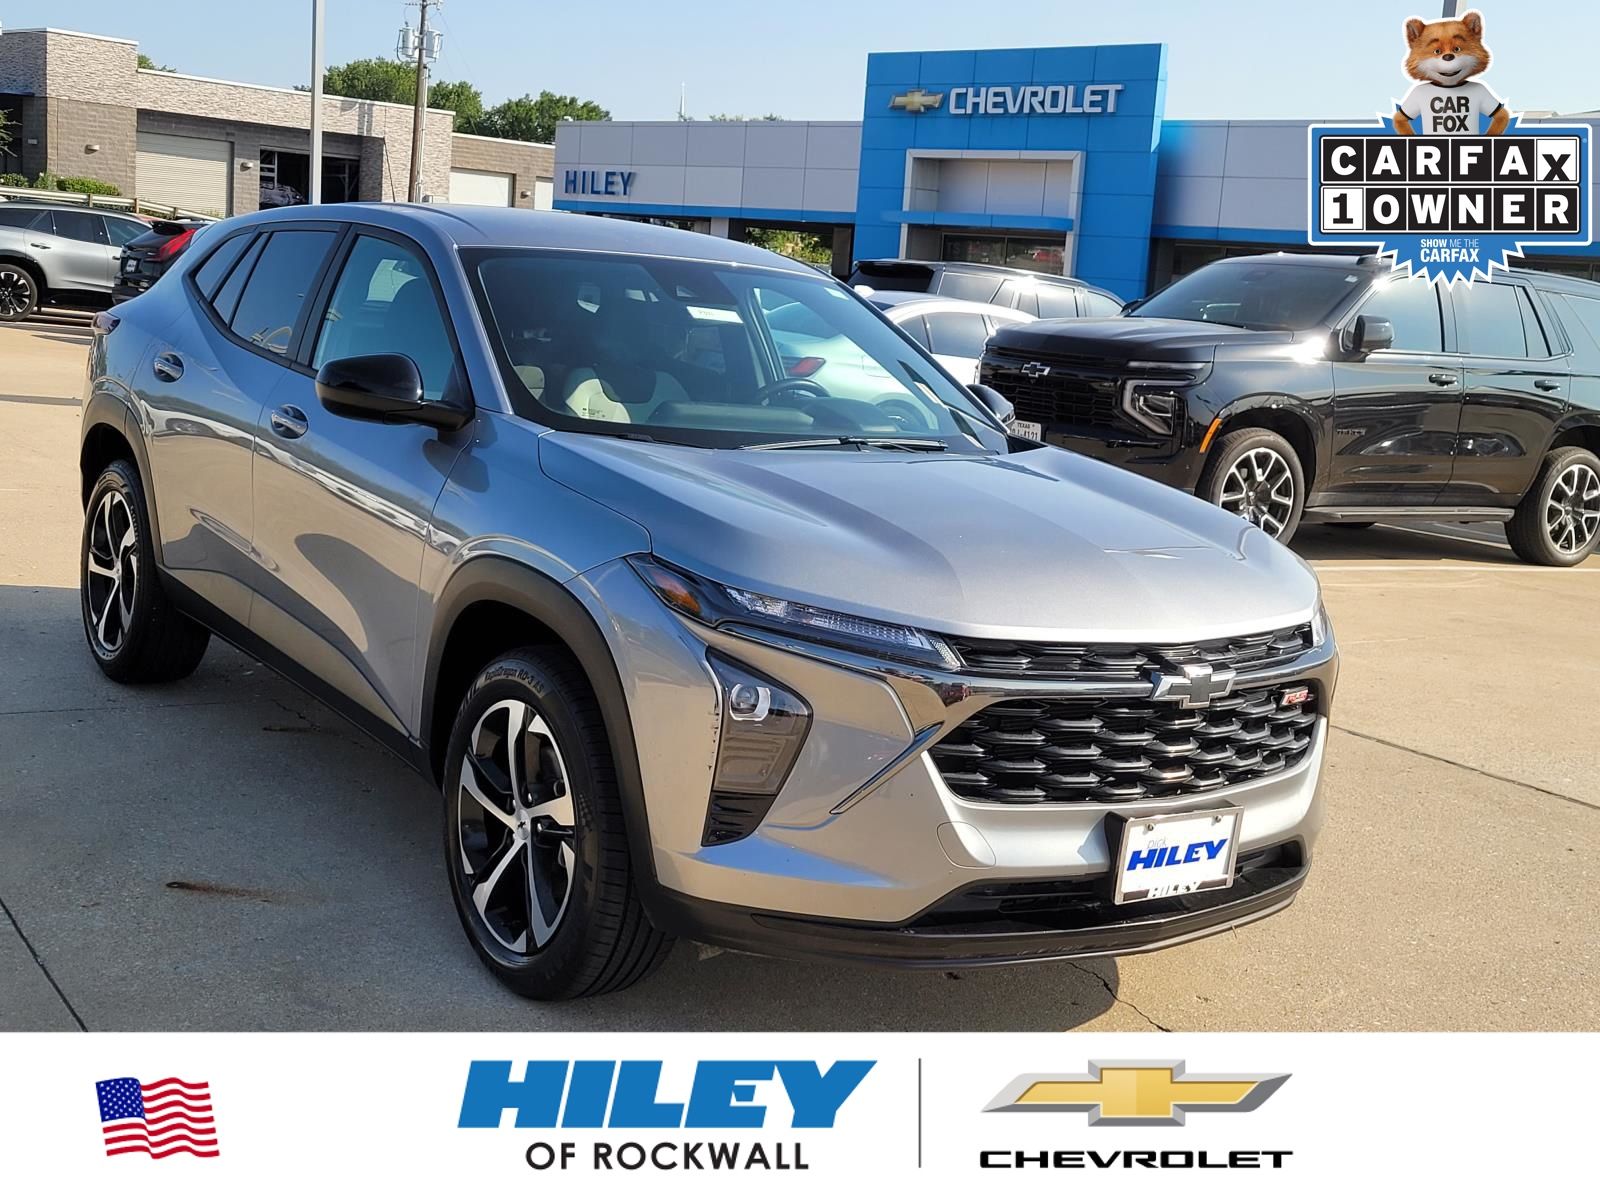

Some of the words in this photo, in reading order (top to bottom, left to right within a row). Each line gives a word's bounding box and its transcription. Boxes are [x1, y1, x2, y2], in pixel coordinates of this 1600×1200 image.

[950, 84, 1125, 115] CHEVROLET
[564, 170, 633, 196] HILEY
[1126, 838, 1228, 871] HILEY
